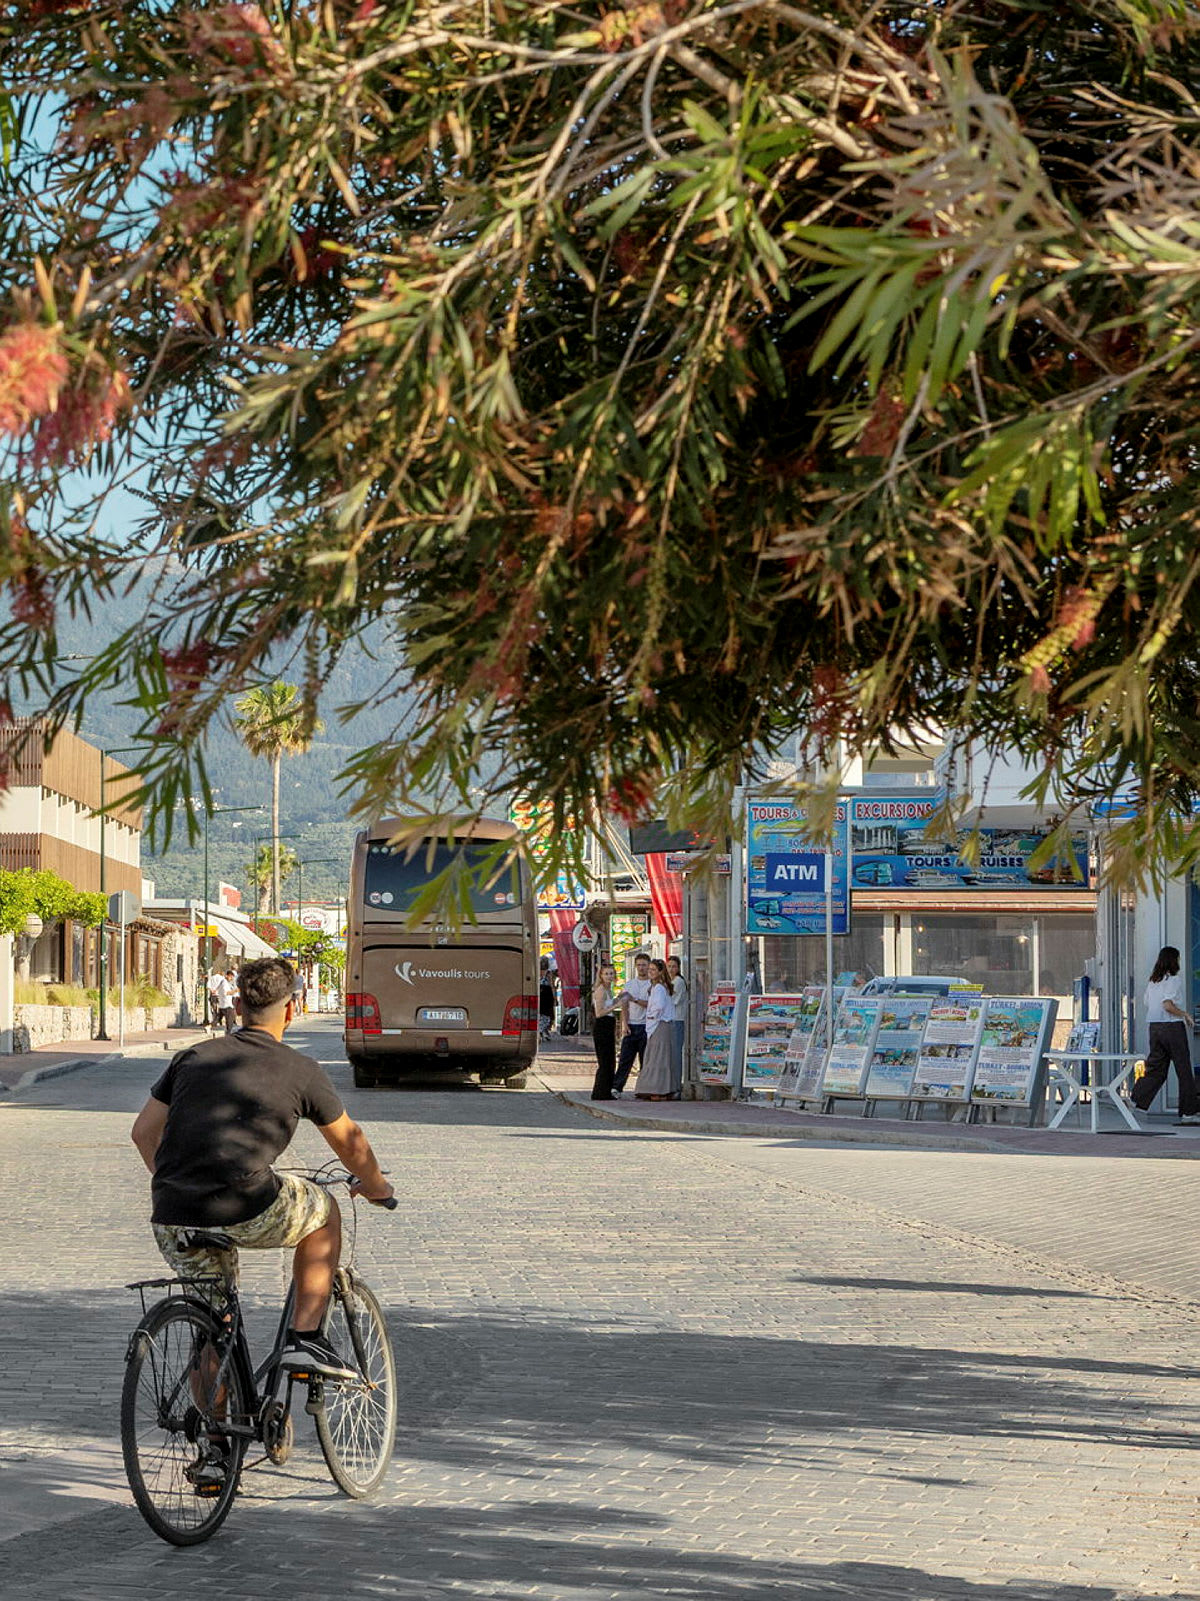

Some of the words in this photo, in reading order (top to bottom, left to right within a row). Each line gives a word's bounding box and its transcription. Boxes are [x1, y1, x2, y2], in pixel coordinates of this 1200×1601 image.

[751, 807, 789, 820] TOURS
[856, 803, 933, 818] EXCURSIONS
[906, 856, 950, 867] TOURS
[976, 857, 1024, 867] RUISES
[774, 865, 818, 880] ATM
[418, 968, 462, 978] Vavoulis
[464, 969, 490, 979] tours
